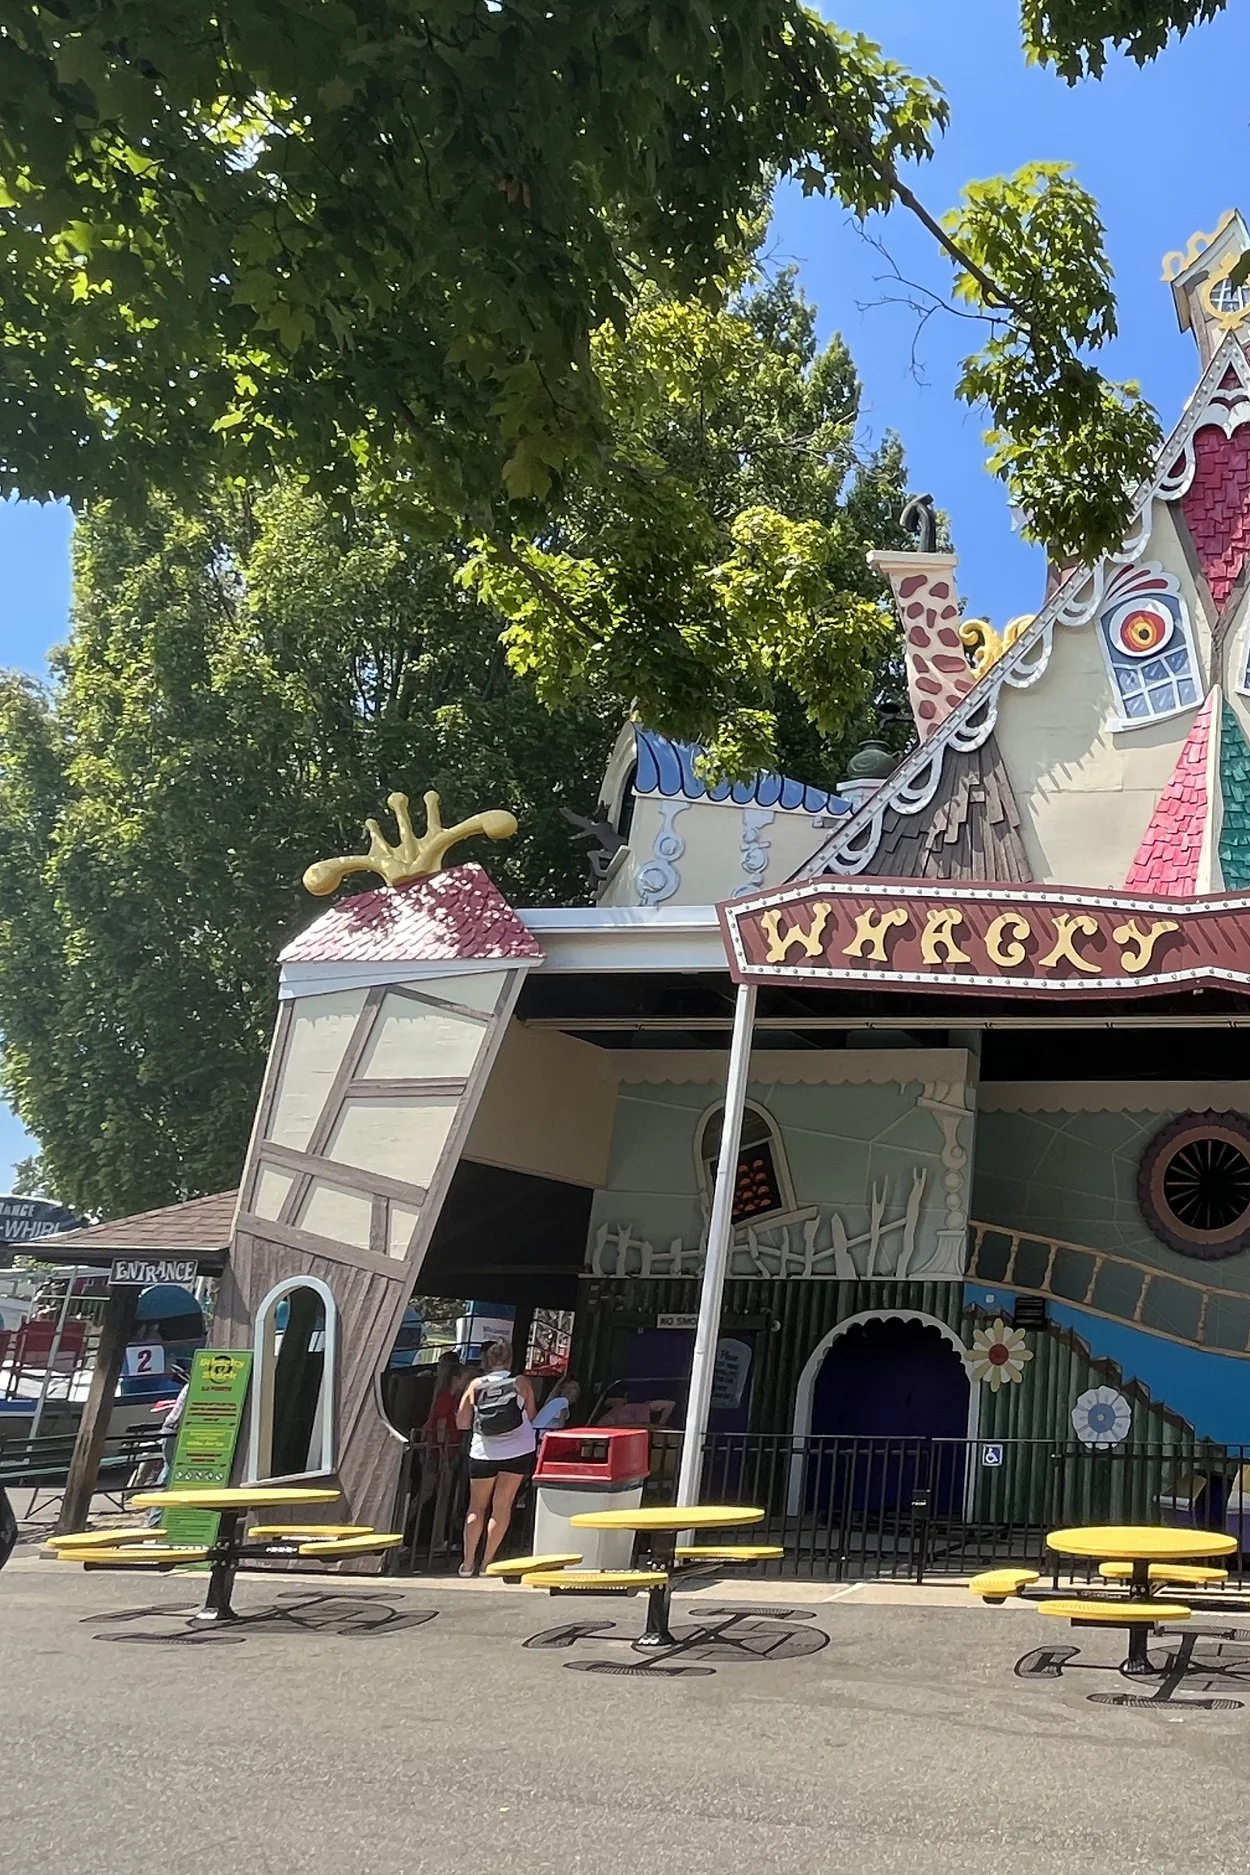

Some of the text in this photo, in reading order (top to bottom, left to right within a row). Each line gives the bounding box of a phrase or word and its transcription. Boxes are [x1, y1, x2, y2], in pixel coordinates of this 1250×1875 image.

[760, 902, 1180, 973] WHACKY
[115, 1261, 195, 1282] ENTRANCE
[137, 1349, 152, 1373] 2
